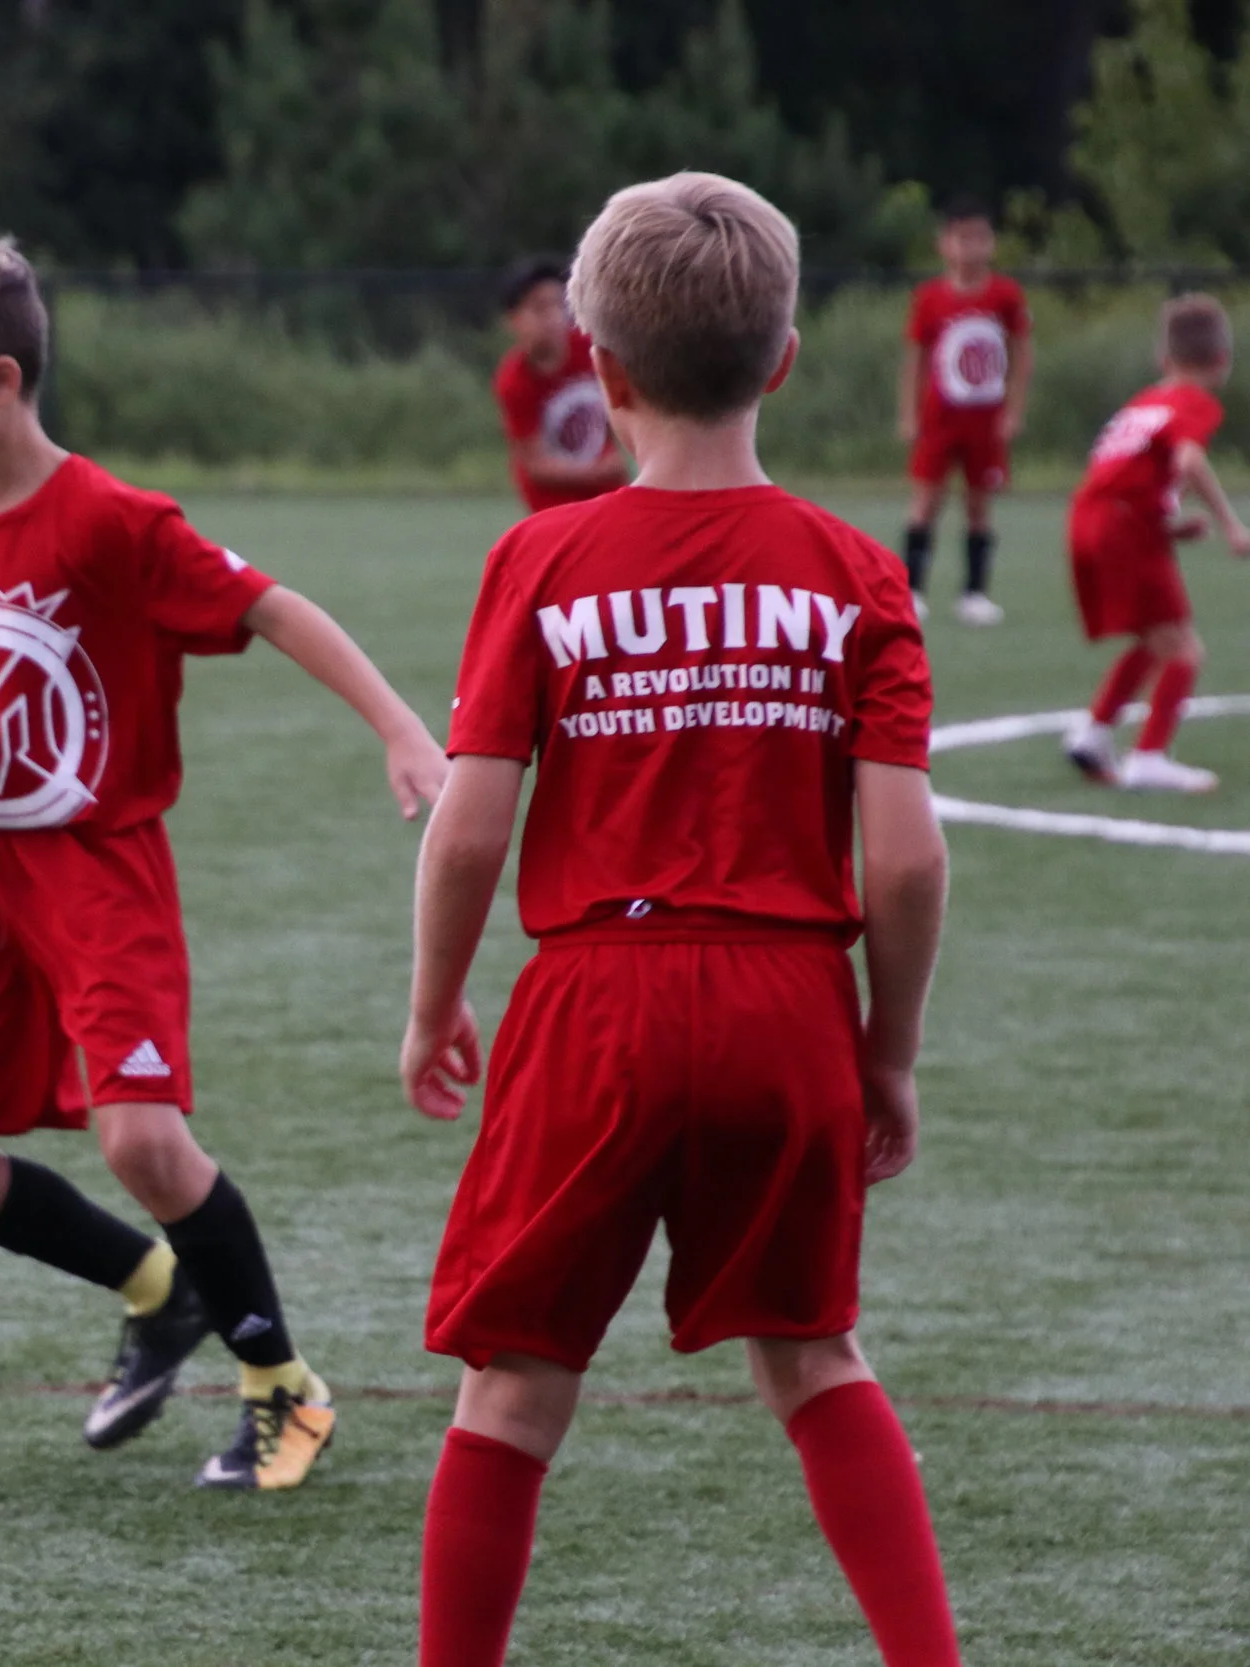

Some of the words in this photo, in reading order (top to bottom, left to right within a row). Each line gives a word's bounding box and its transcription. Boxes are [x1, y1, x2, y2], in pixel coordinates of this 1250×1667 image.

[537, 583, 861, 668] MUTINY
[586, 675, 607, 700] A
[612, 664, 791, 697] REVOLUTION
[800, 668, 825, 694] IN
[560, 708, 655, 738] YOUTH
[664, 701, 846, 738] DEVELOPMENT
